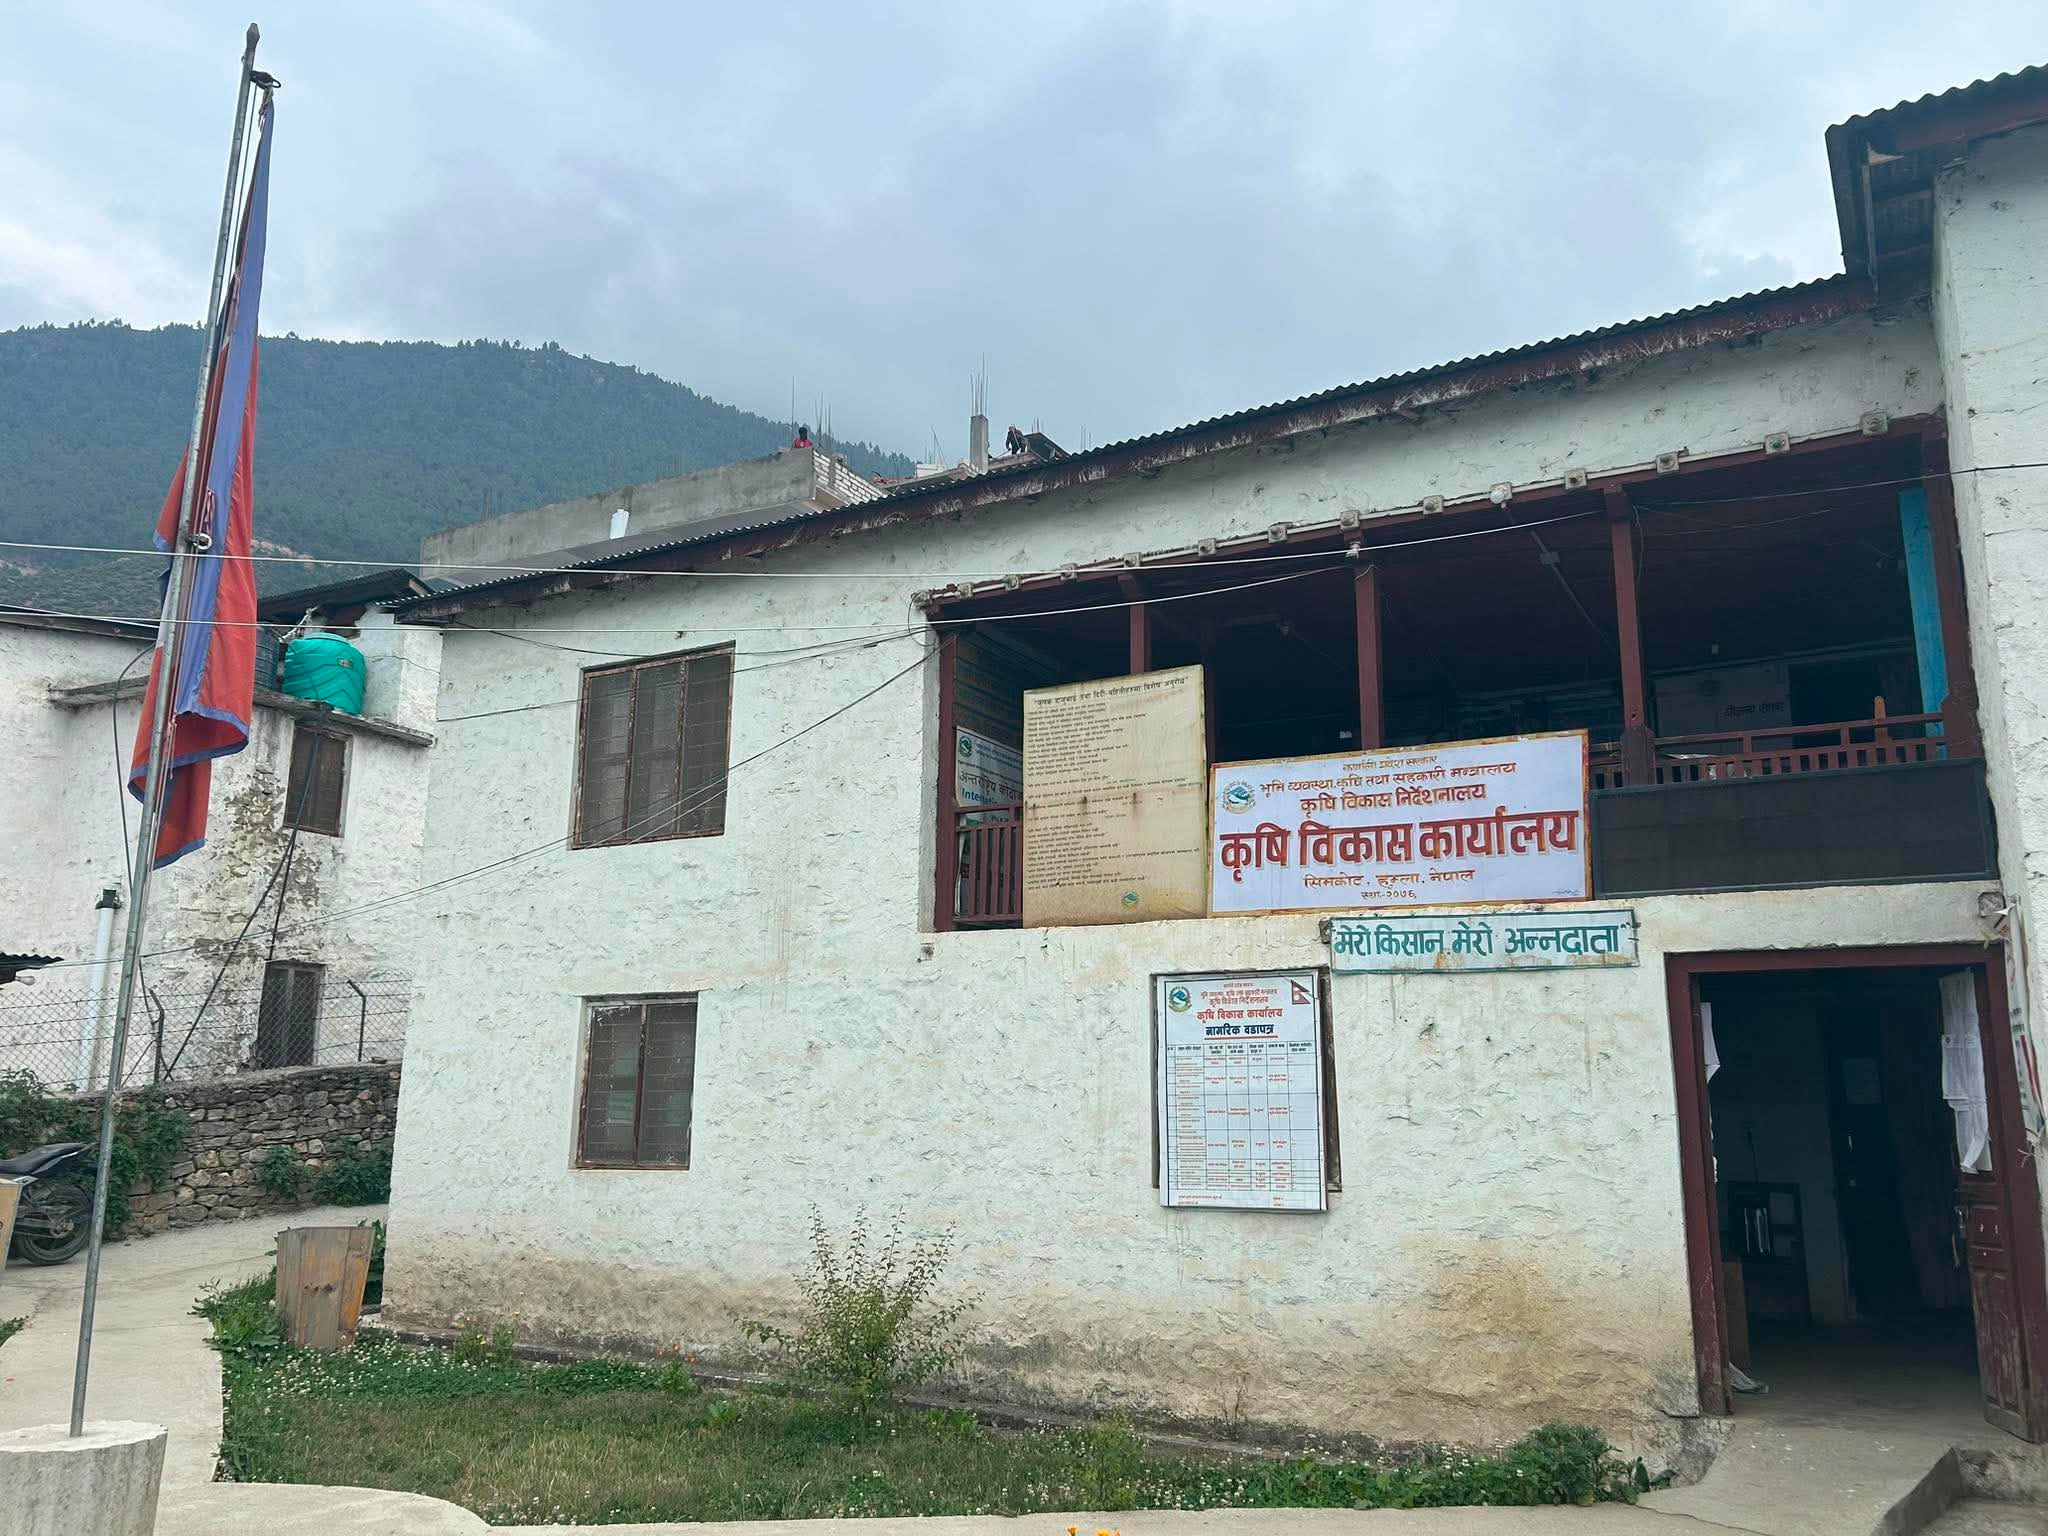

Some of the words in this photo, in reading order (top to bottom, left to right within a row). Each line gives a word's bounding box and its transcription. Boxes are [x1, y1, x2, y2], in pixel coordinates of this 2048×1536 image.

[1259, 779, 1285, 798] भूमि
[1336, 773, 1363, 792] कृषि
[1365, 774, 1390, 788] तथा
[1392, 765, 1446, 784] सहकारी
[1450, 762, 1517, 778] मन्त्रालय
[1299, 792, 1337, 818] कृषि
[1341, 791, 1393, 811] विकास
[1395, 784, 1487, 807] निर्देशनालय
[1219, 822, 1292, 882] कृषि
[1298, 820, 1414, 866] विकास
[1418, 805, 1580, 860] कार्यालय
[1428, 867, 1476, 882] नेपाल
[1334, 924, 1371, 956] मेरो
[1374, 923, 1445, 957] किसान
[1451, 920, 1494, 956] मेरो
[1196, 1008, 1215, 1023] कृषि
[1217, 1008, 1244, 1020] विकास
[1247, 1005, 1283, 1019] कार्यालय
